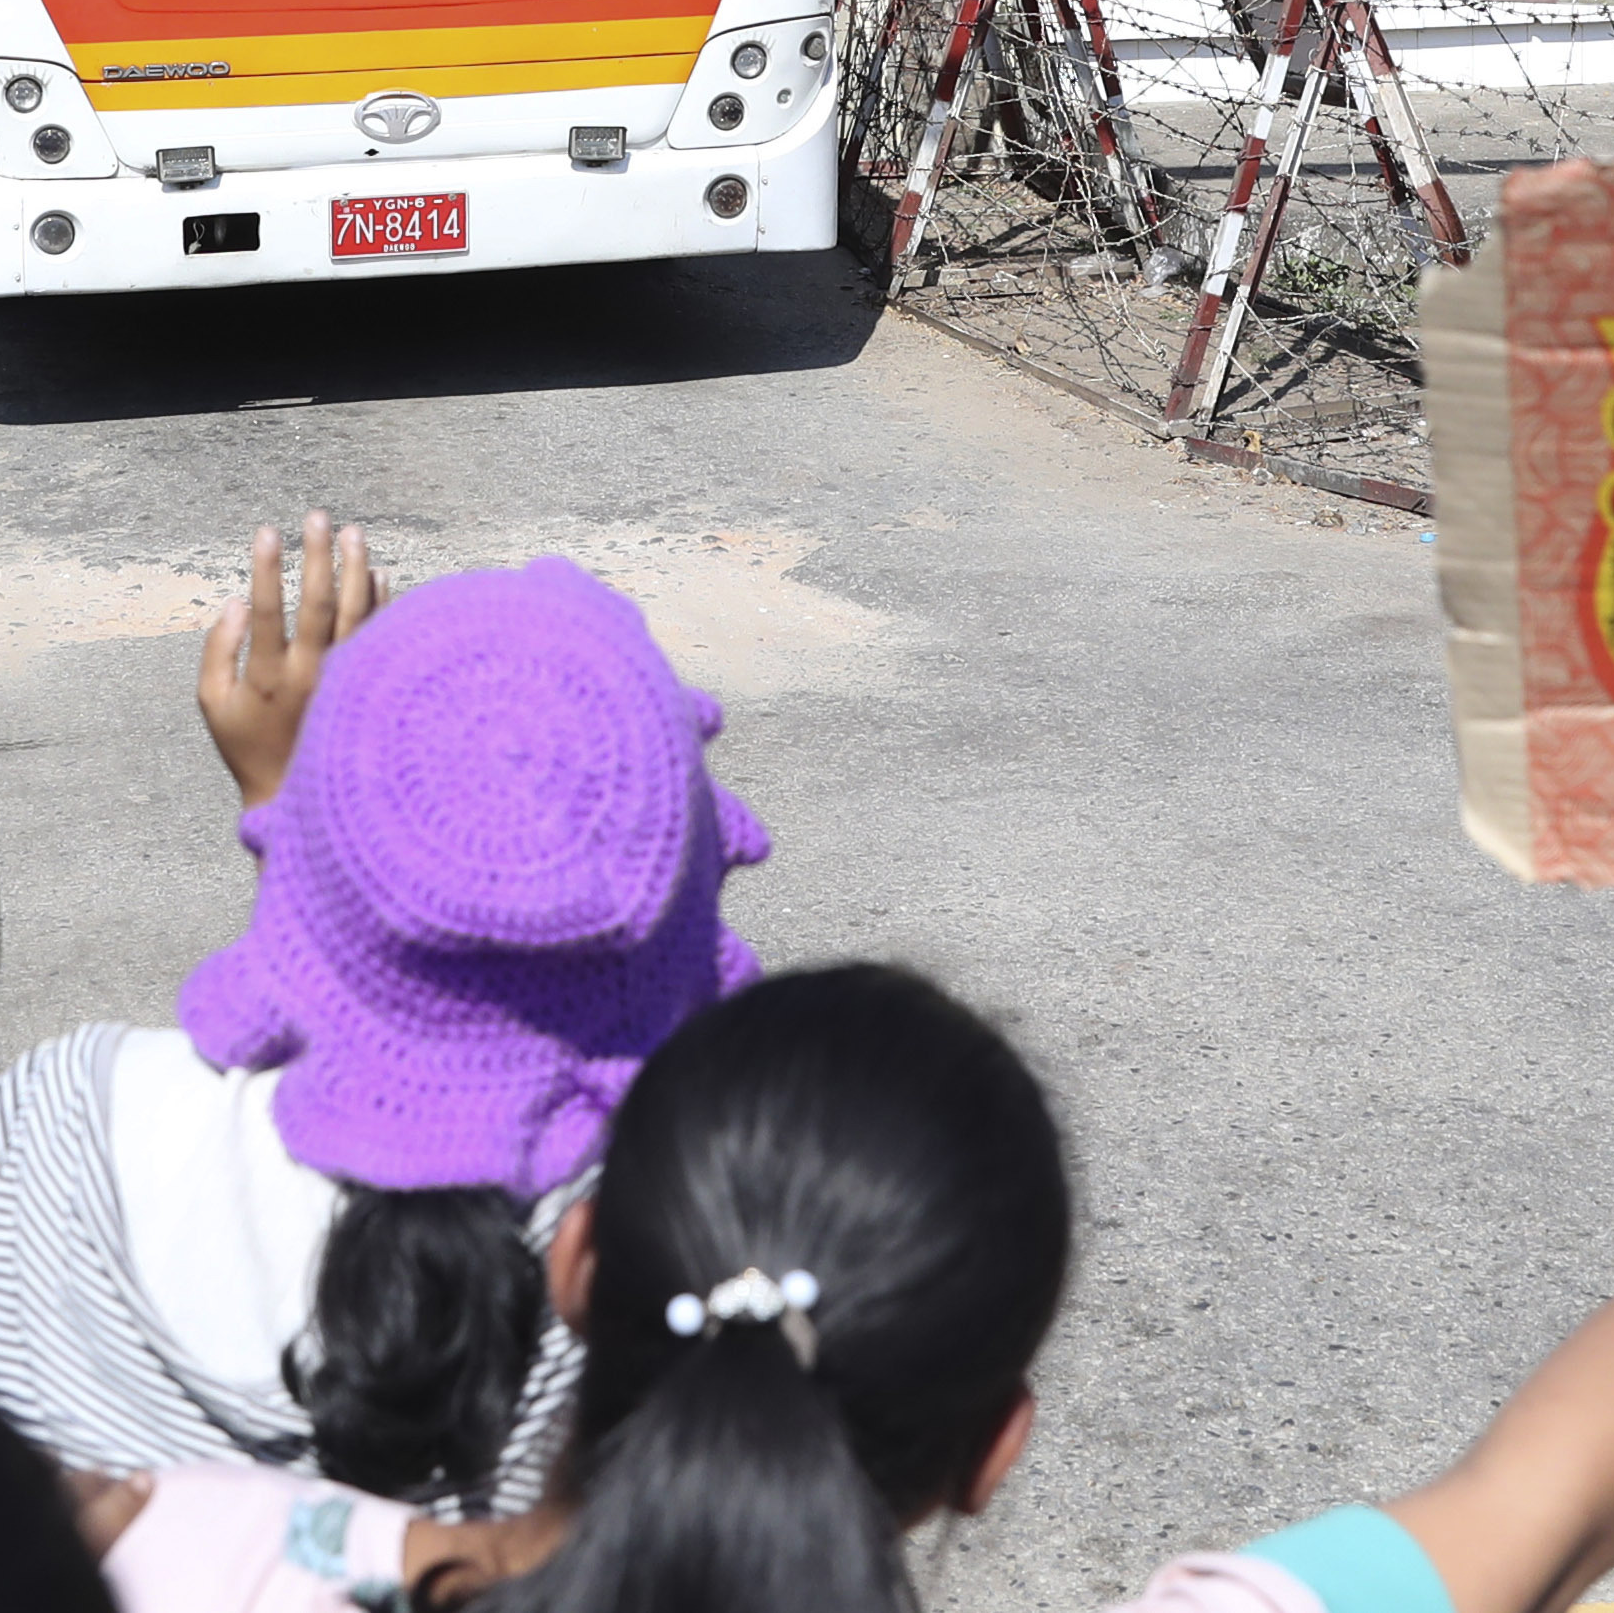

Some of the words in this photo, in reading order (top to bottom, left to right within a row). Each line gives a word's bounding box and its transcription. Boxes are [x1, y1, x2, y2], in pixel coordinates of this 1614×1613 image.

[103, 61, 230, 79] DAEWOO
[372, 197, 426, 211] YGN-6
[336, 208, 461, 246] 7N-8414
